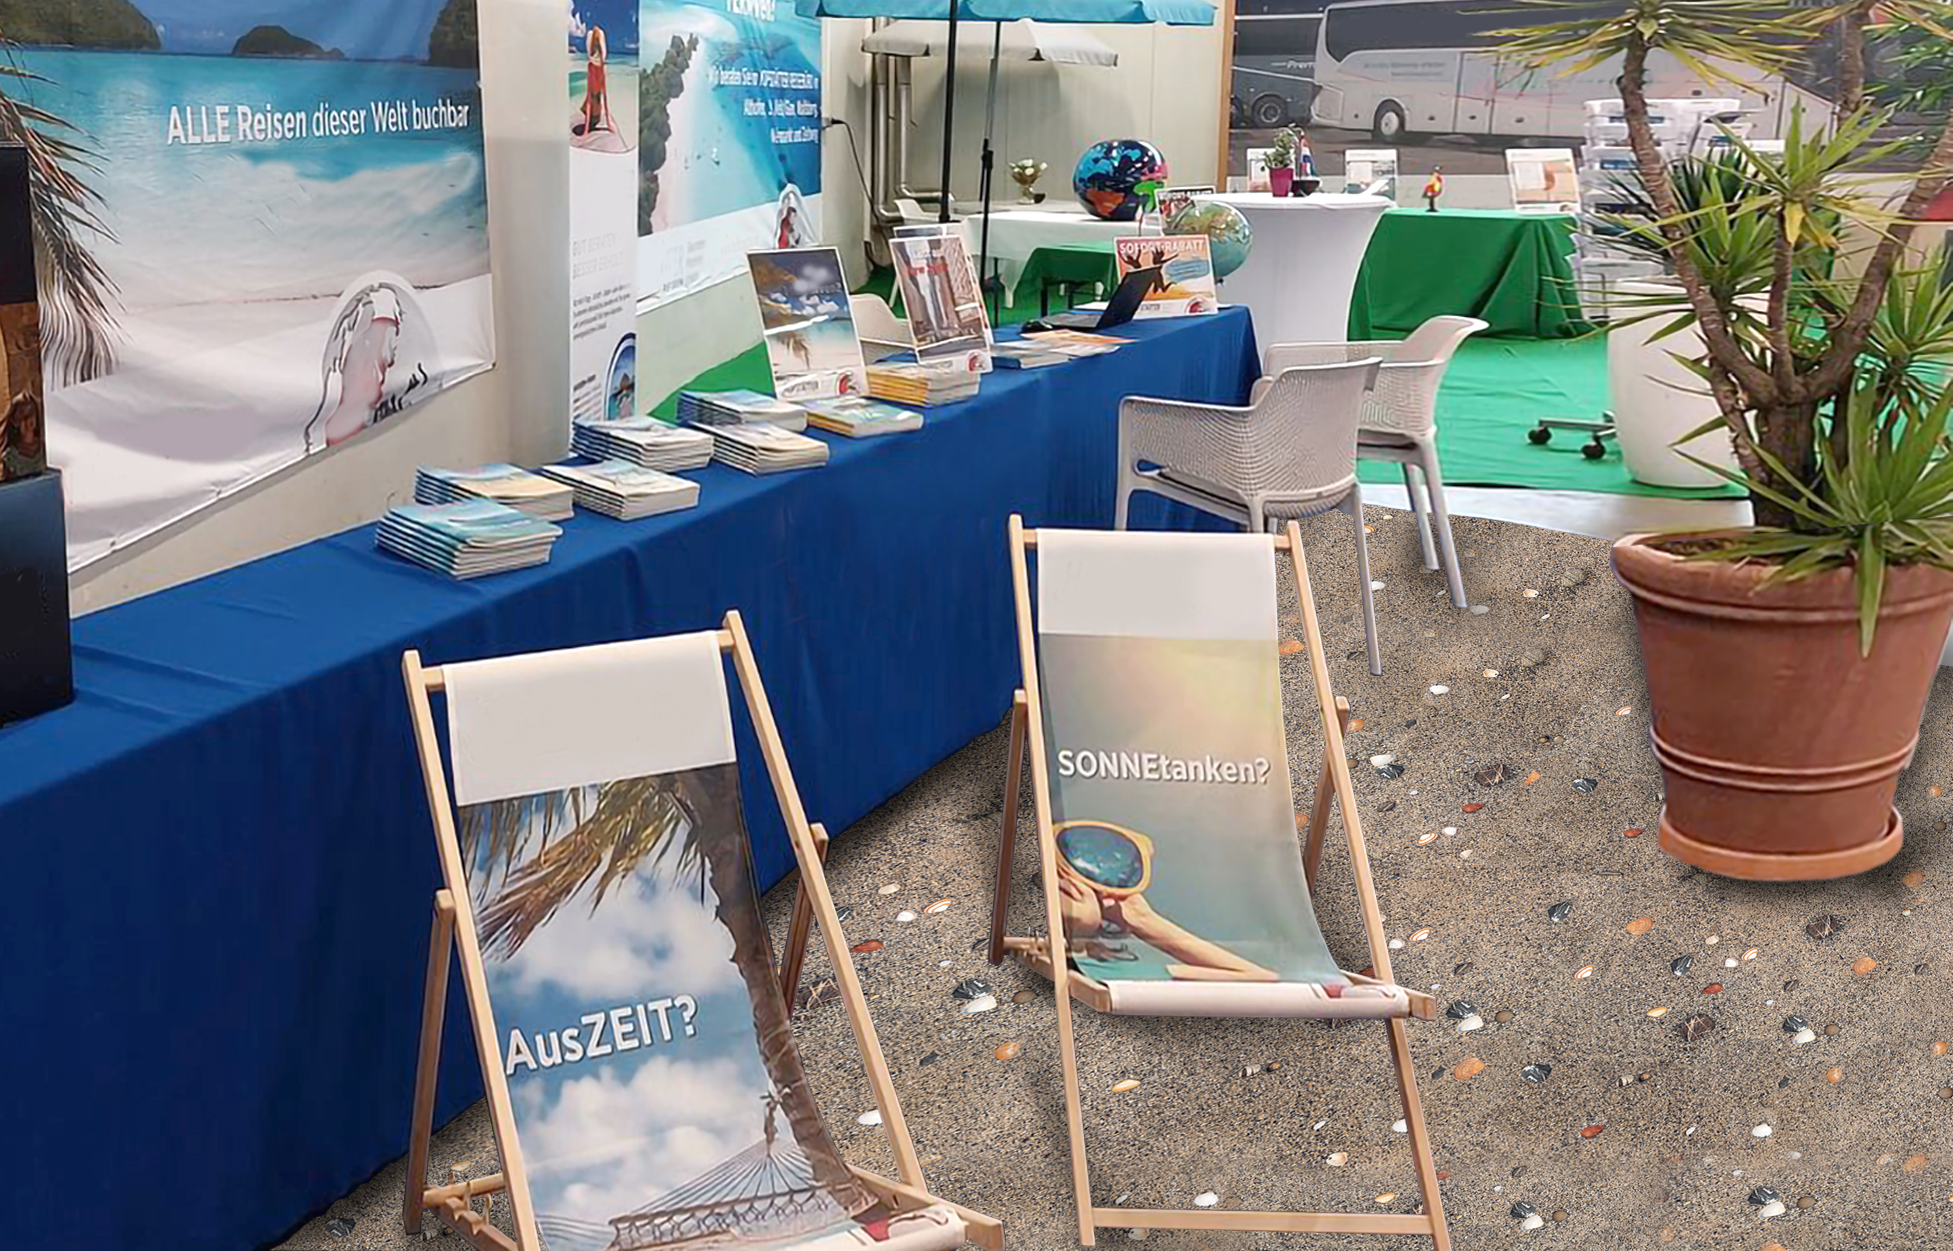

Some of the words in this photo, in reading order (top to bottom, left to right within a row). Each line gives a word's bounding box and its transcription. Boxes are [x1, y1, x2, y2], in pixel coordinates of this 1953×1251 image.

[167, 105, 231, 144] ALLE
[237, 102, 306, 141] Reisen
[312, 102, 367, 138] dieser
[371, 99, 409, 133] Welt
[412, 97, 469, 130] buchbar
[1057, 750, 1272, 784] SONNEtanken?
[505, 993, 698, 1076] AusZEIT?
